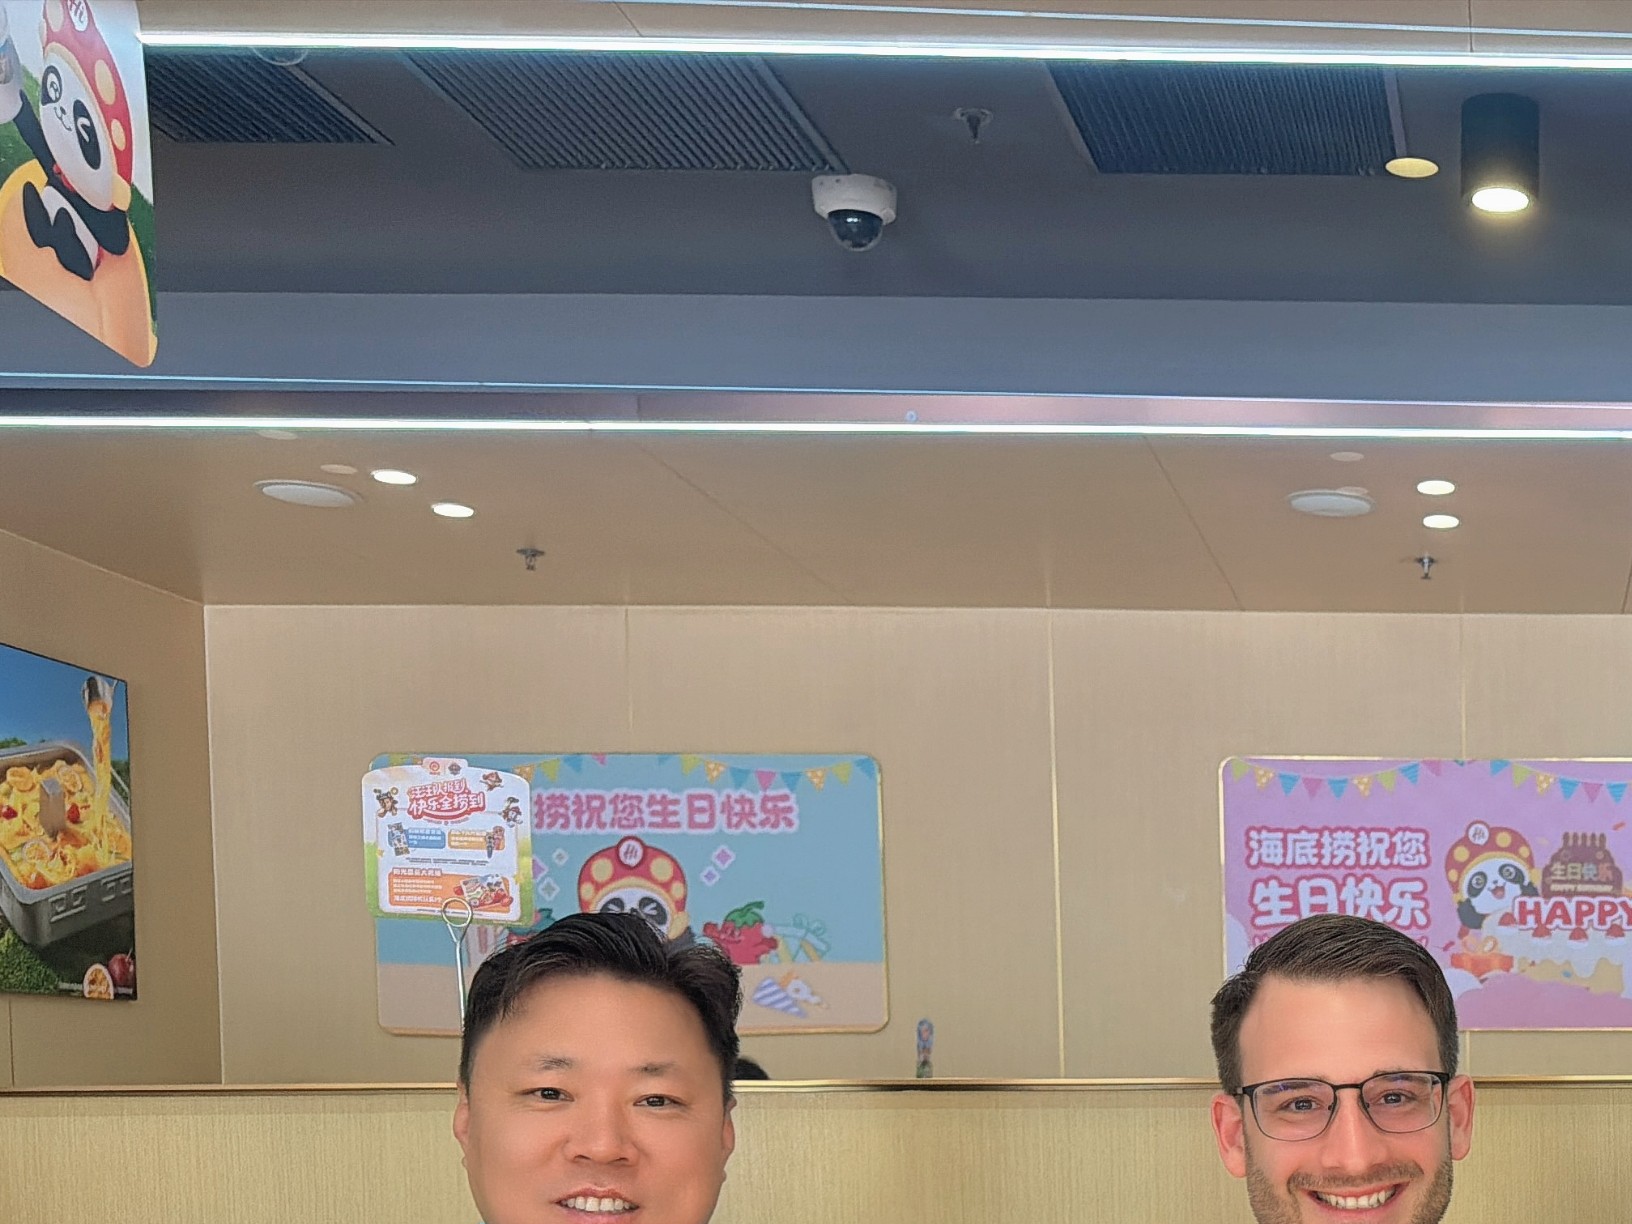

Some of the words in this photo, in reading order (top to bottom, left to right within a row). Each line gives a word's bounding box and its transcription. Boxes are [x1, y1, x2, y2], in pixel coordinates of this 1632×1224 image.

[533, 792, 797, 832] 捞祝您生日快乐
[1249, 829, 1428, 867] 海底捞祝您
[1252, 875, 1429, 926] 生日快乐
